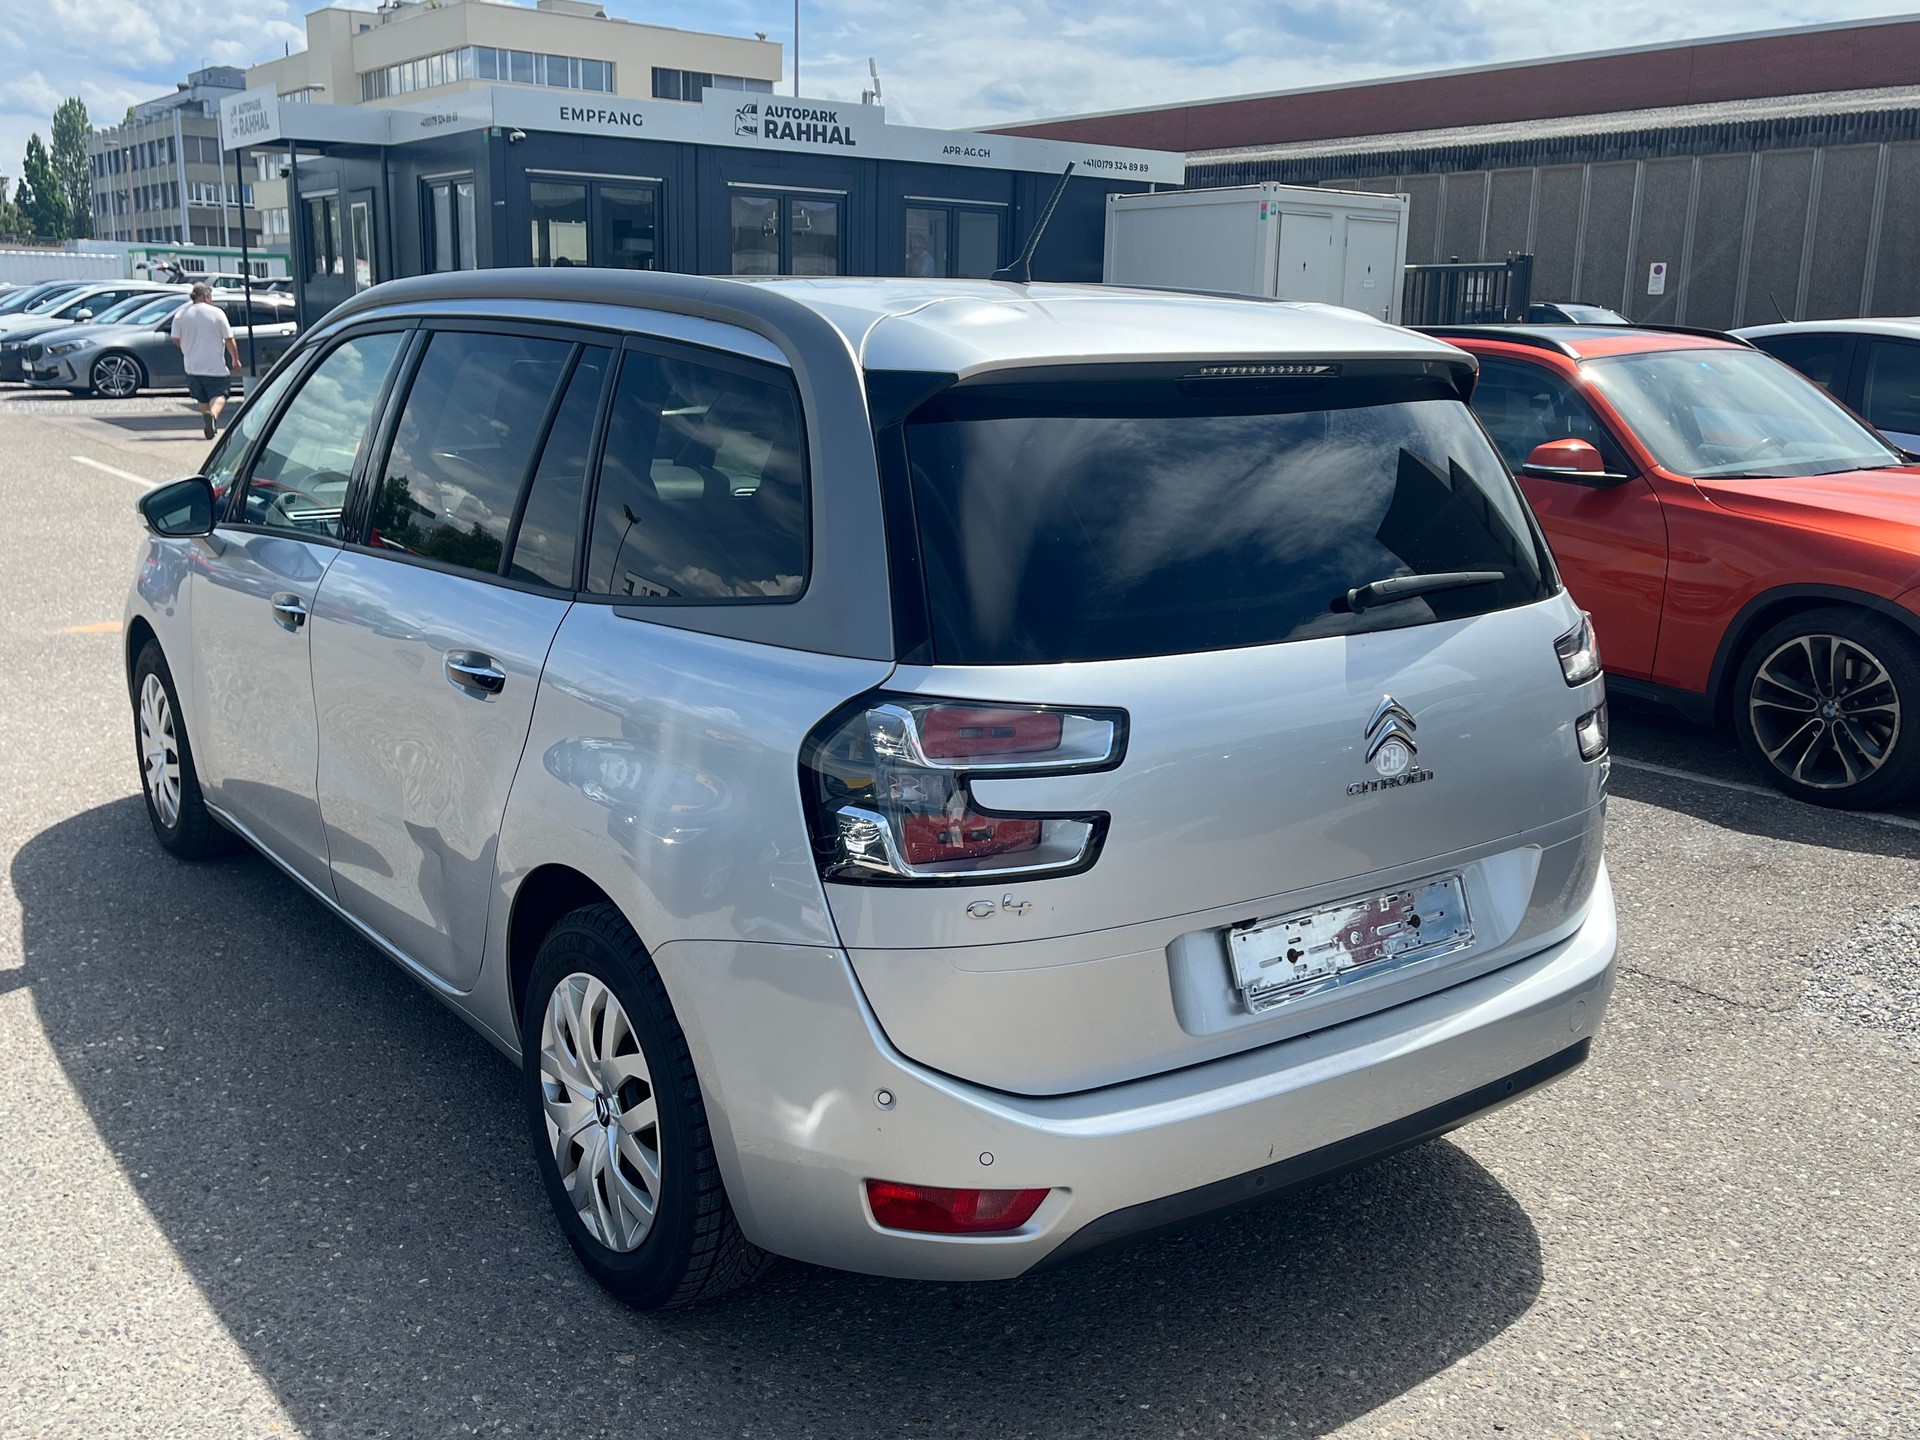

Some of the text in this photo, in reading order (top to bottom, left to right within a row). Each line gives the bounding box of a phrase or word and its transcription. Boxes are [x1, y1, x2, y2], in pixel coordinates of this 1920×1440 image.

[560, 106, 643, 126] EMPFANG
[765, 105, 837, 123] AUTOPARK
[764, 119, 856, 146] RAHHAL
[942, 145, 991, 158] APR-AG.CH
[1083, 159, 1149, 172] +41(0)79 324 89 89
[1380, 748, 1400, 771] CH
[966, 893, 1033, 920] C4
